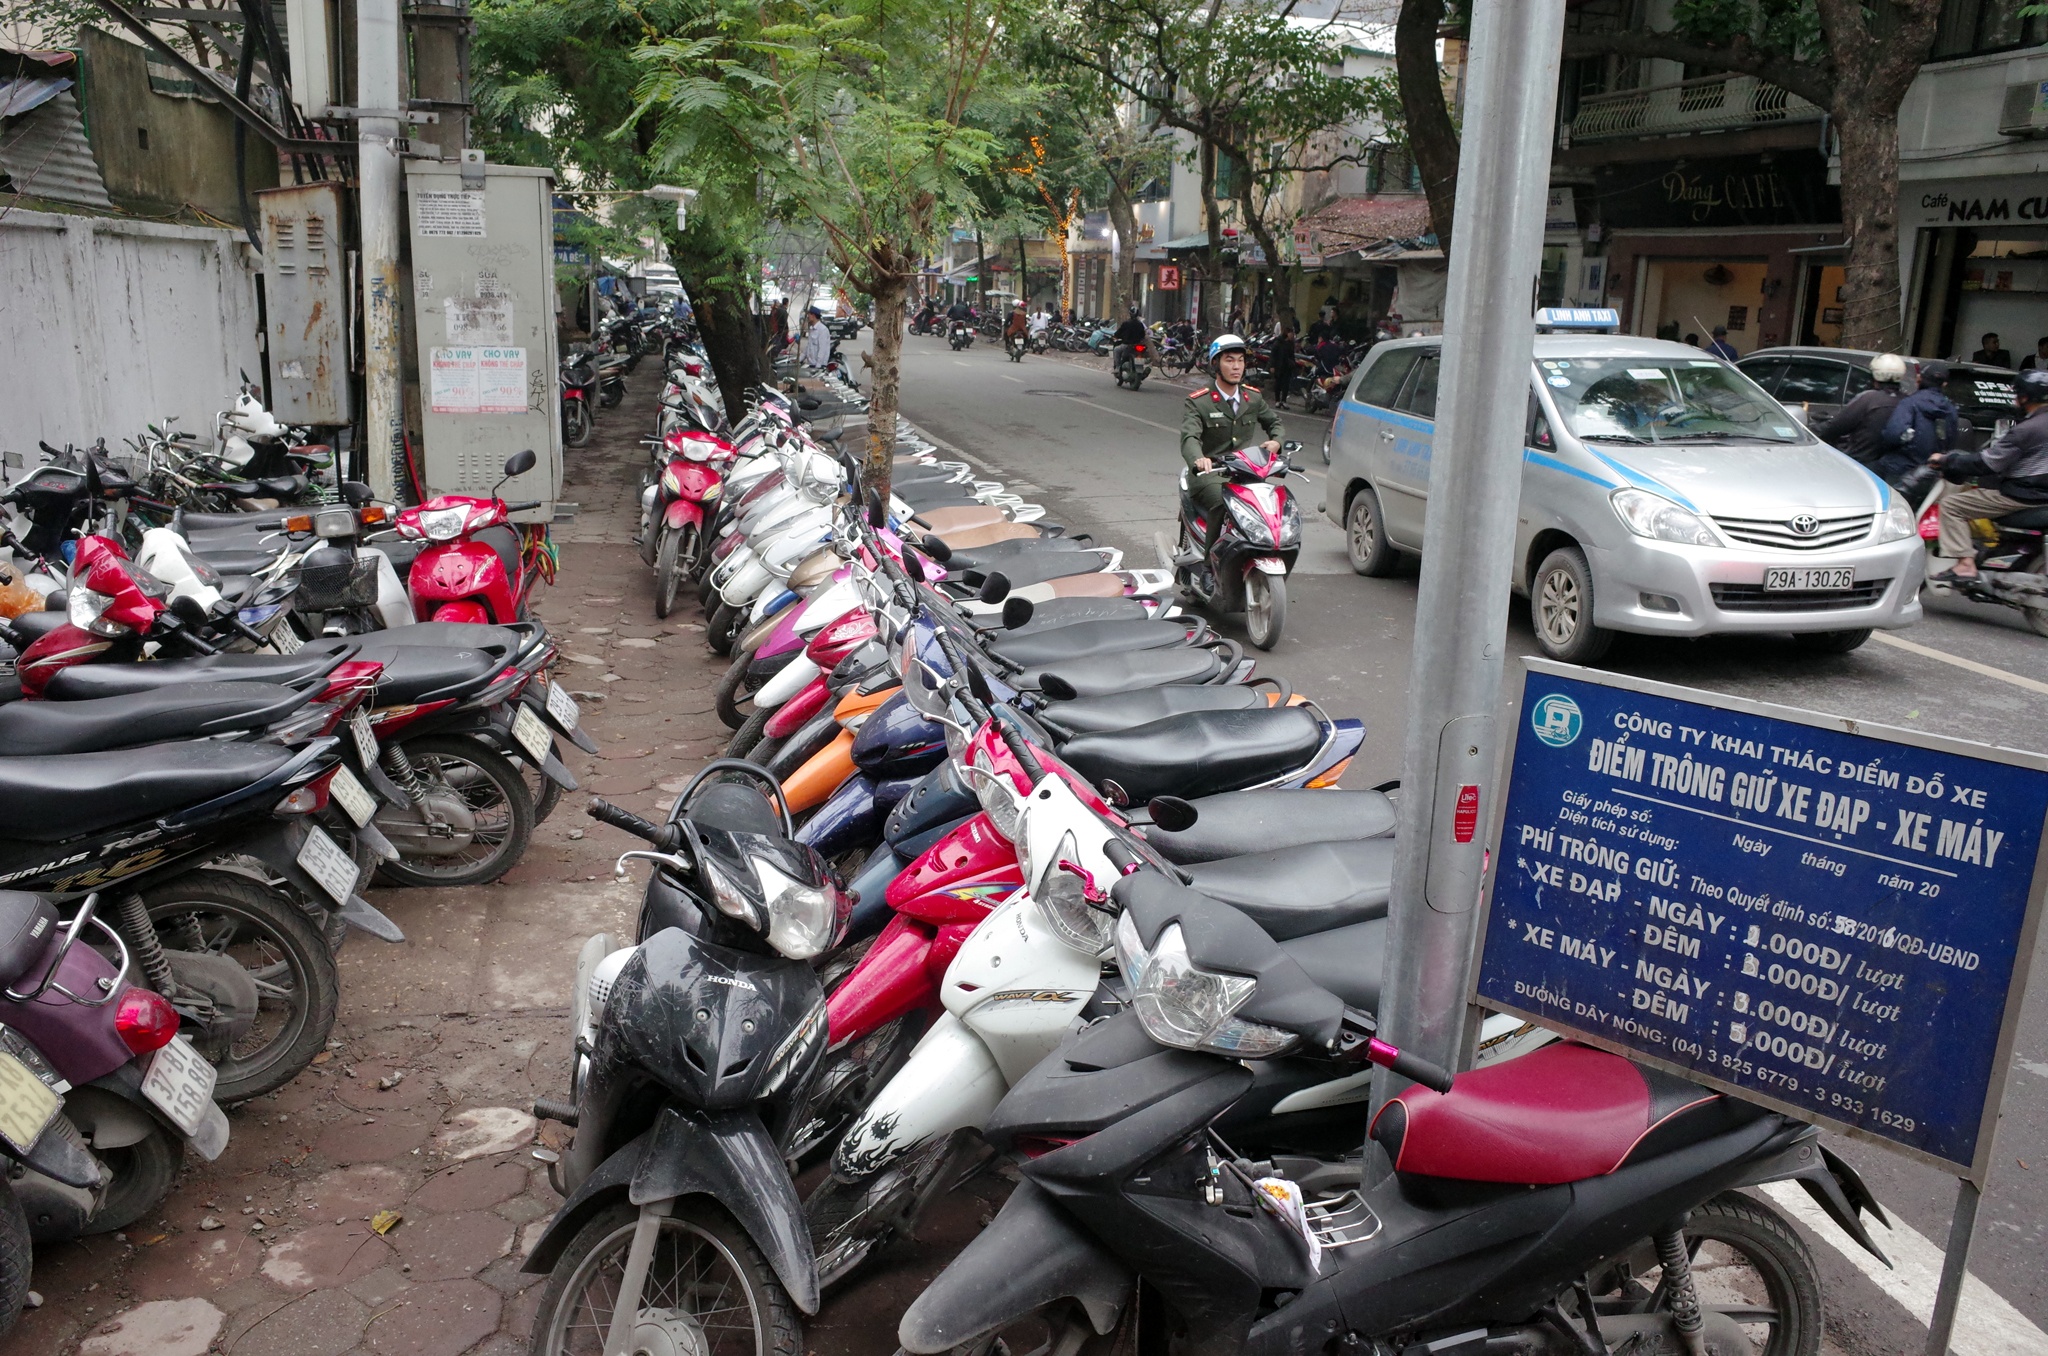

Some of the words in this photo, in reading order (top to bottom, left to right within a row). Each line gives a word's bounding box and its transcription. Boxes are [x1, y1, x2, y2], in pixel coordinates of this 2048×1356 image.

[1921, 193, 1948, 208] Café
[1948, 198, 2009, 221] NAM
[1551, 310, 1572, 321] LINH
[1573, 310, 1592, 322] ANH
[1591, 310, 1612, 322] TAXI
[456, 351, 472, 359] VAY
[484, 350, 501, 358] CHO
[504, 350, 520, 358] VAY
[1769, 571, 1851, 588] 29A-130.26
[1614, 712, 1673, 739] CÔNG
[1679, 726, 1706, 745] TY
[1711, 734, 1764, 759] KHAI
[1770, 746, 1832, 774] THÁC
[1838, 758, 1900, 789] ĐIỂM
[1906, 772, 1945, 798] ĐỖ
[1951, 785, 1988, 809] XE
[1588, 732, 1646, 783] ĐIỂM
[1651, 752, 1726, 802] TRÔNG
[1730, 768, 1778, 813] GIỮ
[1776, 782, 1812, 823] XE
[1815, 791, 1870, 840] ĐẠP
[1892, 809, 1932, 852] XE
[1936, 818, 2004, 868] MÁY
[1559, 807, 1588, 826] Diện
[1592, 816, 1616, 833] tích
[1619, 824, 1639, 838] sử
[1639, 830, 1680, 851] dụng:
[1562, 790, 1592, 808] Giấy
[1593, 798, 1628, 820] phép
[1630, 808, 1653, 824] số:
[1732, 834, 1772, 856] Ngày
[1801, 852, 1847, 877] tháng
[1877, 873, 1915, 892] năm
[1918, 882, 1940, 898] 20
[0, 851, 90, 884] SIRIUS
[304, 834, 334, 875] 35-B2
[325, 851, 356, 899] 031.45
[1520, 824, 1556, 852] PHÍ
[1559, 834, 1630, 874] TRÔNG
[1636, 858, 1680, 890] GIỮ:
[1690, 876, 1724, 900] Theo
[1726, 886, 1770, 914] Quyết
[1772, 902, 1804, 922] định
[1807, 911, 1832, 931] số:
[30, 916, 48, 938] YAMAHA
[1015, 911, 1029, 942] HONDA
[1532, 861, 1564, 888] XE
[1570, 872, 1621, 904] ĐẠP
[1648, 896, 1726, 935] NGÀY
[1856, 961, 1905, 991] lượt
[706, 974, 758, 992] HONDA
[1522, 922, 1554, 950] XE
[1559, 938, 1616, 968] MÁY
[1635, 960, 1712, 1000] NGÀY
[1839, 1029, 1888, 1061] lượt
[1643, 924, 1701, 960] ĐÊM
[1852, 992, 1902, 1023] lượt
[1514, 980, 1571, 1011] ĐƯỜNG
[1574, 1002, 1610, 1024] DÂY
[1612, 1015, 1667, 1045] NÓNG:
[1672, 1036, 1702, 1060] (04)
[1707, 1050, 1717, 1063] 3
[1722, 1055, 1752, 1076] 825
[1756, 1066, 1800, 1091] 6779
[1815, 1087, 1826, 1101] 3
[1830, 1092, 1864, 1115] 933
[1871, 1107, 1916, 1132] 1629
[1632, 988, 1689, 1024] ĐÊM
[1838, 1060, 1886, 1094] lượt
[150, 1042, 188, 1101] 37-B1
[174, 1057, 212, 1127] 158.88
